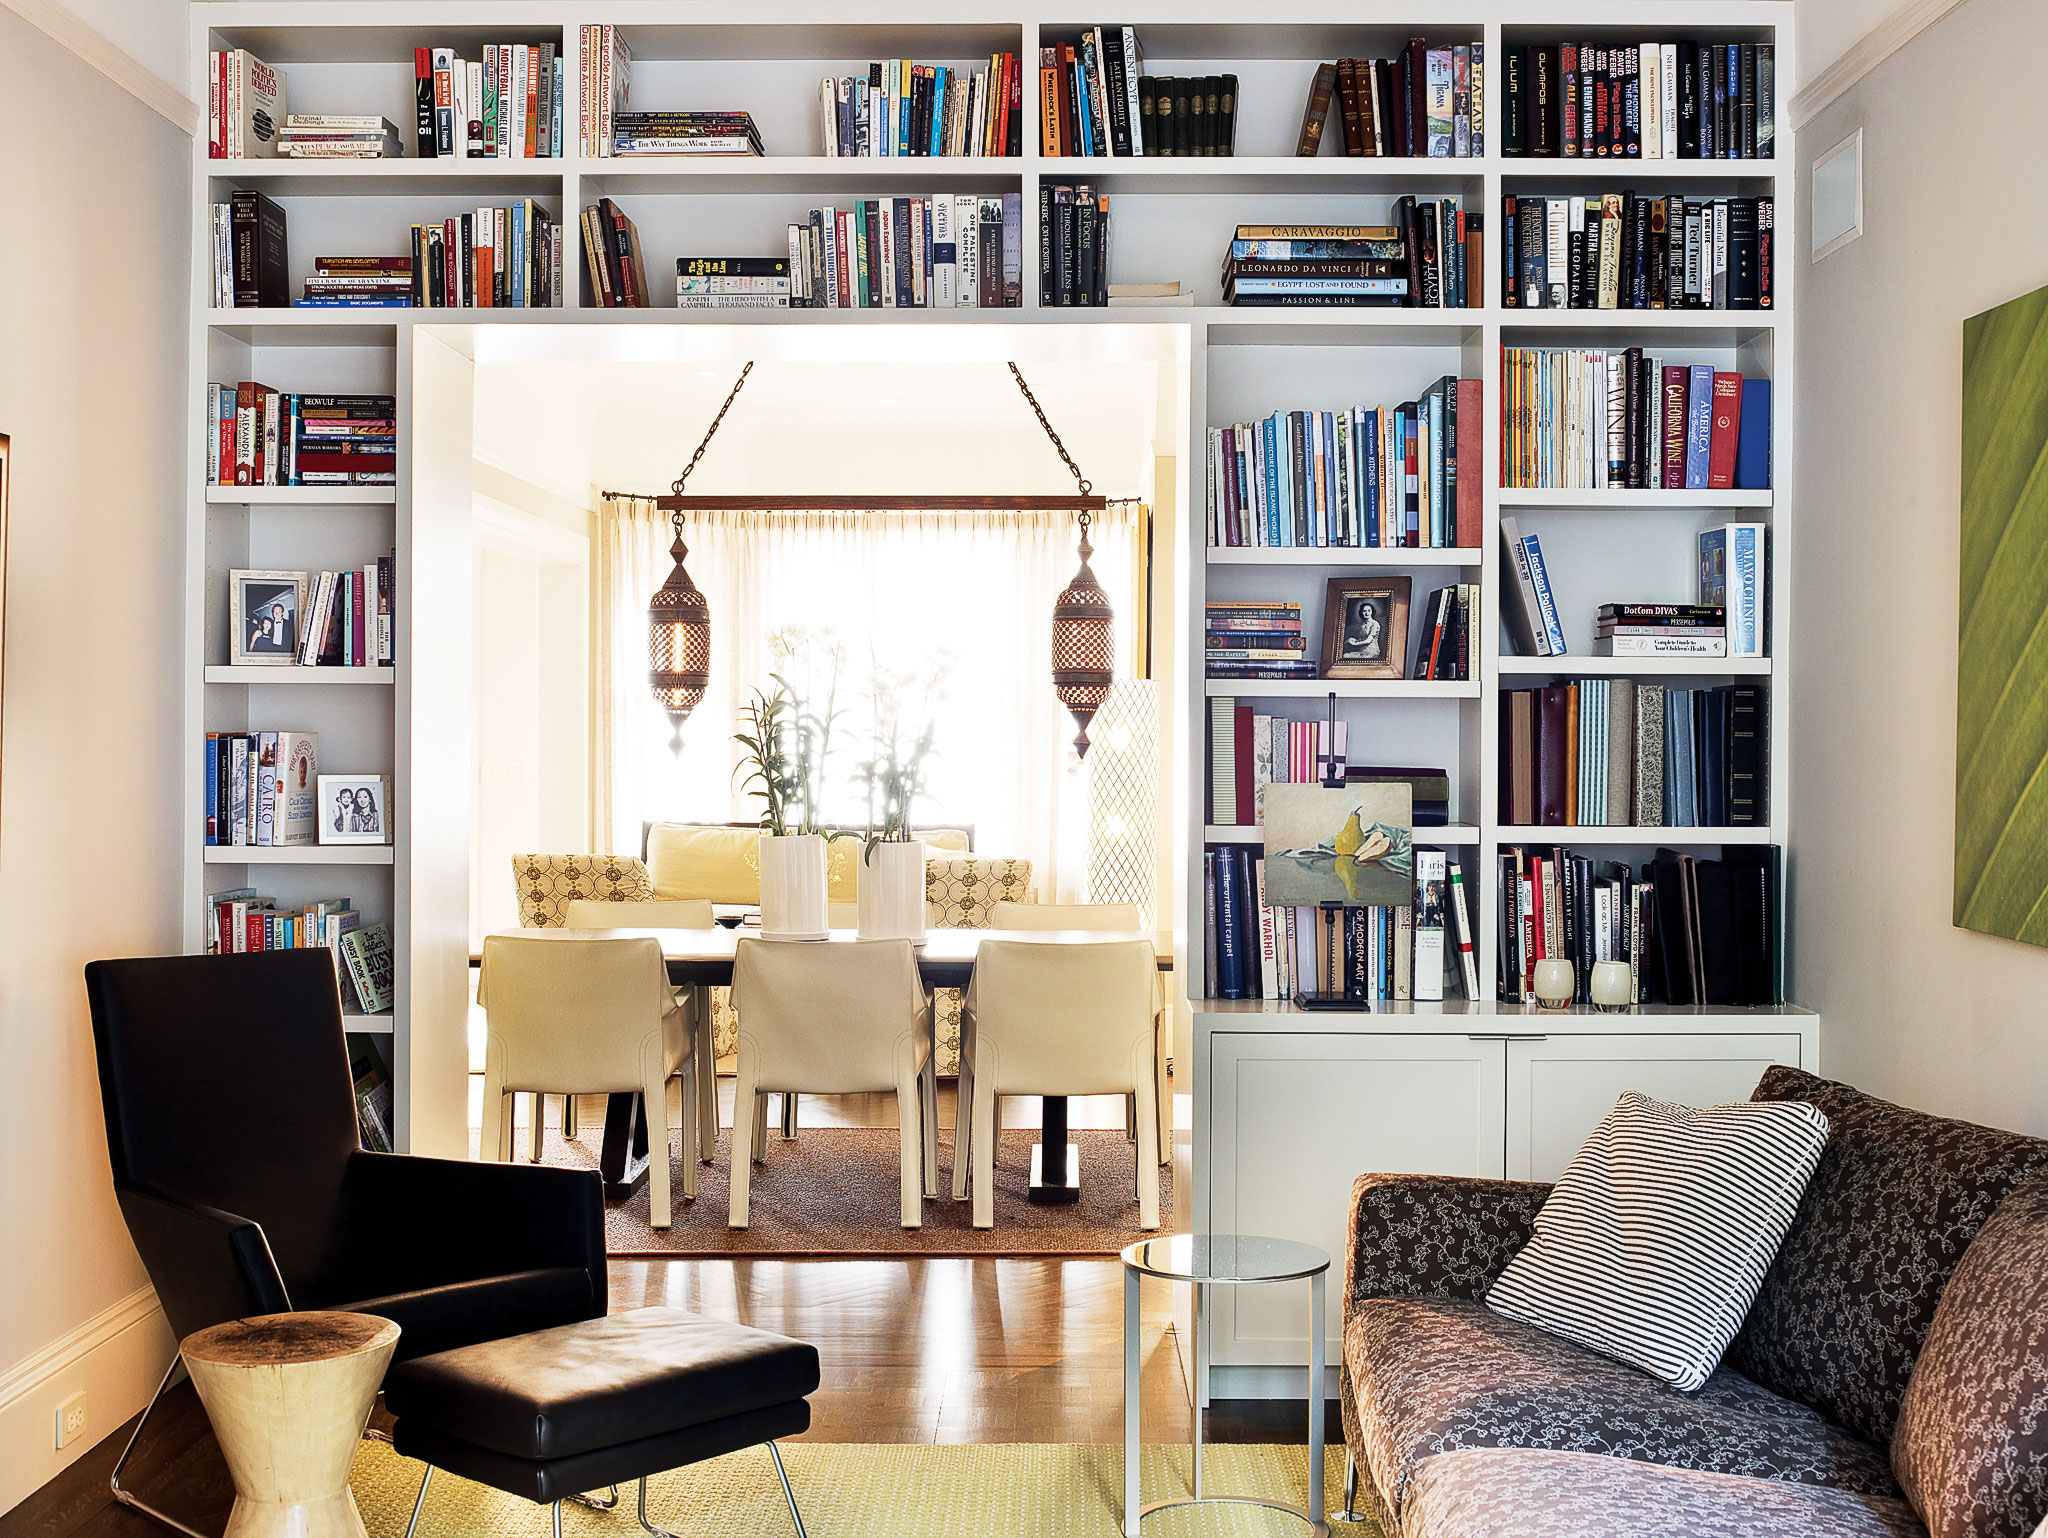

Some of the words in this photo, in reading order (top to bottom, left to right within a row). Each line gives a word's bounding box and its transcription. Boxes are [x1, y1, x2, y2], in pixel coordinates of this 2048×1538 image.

[581, 26, 589, 45] Das
[581, 47, 589, 72] dritte
[1124, 33, 1135, 74] ANCIENT
[1609, 49, 1617, 78] WEBER
[251, 68, 277, 89] POLITICS
[253, 60, 274, 79] WORLD
[500, 48, 509, 97] MONEYBALL
[1113, 61, 1122, 80] LATE
[1583, 76, 1592, 85] IN
[252, 77, 277, 97] DEBATED
[442, 80, 450, 92] World
[581, 74, 589, 113] Antwort
[602, 74, 610, 112] Antwort
[1128, 76, 1138, 106] EGYPT
[1584, 86, 1593, 111] ENEMY
[1612, 82, 1620, 103] Flag
[443, 96, 451, 105] Flat
[1116, 81, 1126, 127] ANTIQUITY
[440, 111, 448, 126] Thomas
[499, 100, 509, 127] MICHAEL
[581, 114, 589, 138] Buch
[602, 114, 610, 138] Buch
[1584, 113, 1593, 139] HANDS
[418, 127, 432, 135] Oil
[499, 127, 508, 146] LEWIS
[1049, 118, 1057, 139] LATIN
[1613, 115, 1621, 139] Exile
[1632, 124, 1639, 134] OF
[1083, 208, 1091, 218] IN
[825, 225, 833, 243] THE
[1064, 206, 1072, 249] THROUGH
[1083, 221, 1092, 249] FOCUS
[1272, 227, 1361, 237] CARAVAGGIO
[1549, 212, 1566, 268] Churchill
[1588, 222, 1598, 252] MARTHA
[1689, 223, 1699, 244] Ted
[857, 233, 866, 261] JAPAN
[1760, 234, 1769, 255] Flag
[826, 244, 835, 282] WARRIOR
[859, 261, 868, 278] INC.
[1064, 250, 1072, 268] THE
[1241, 264, 1298, 272] LEONARDO
[1321, 265, 1351, 273] VINCI
[1571, 233, 1581, 299] CLEOPATRA
[1689, 246, 1699, 287] Turner
[1064, 270, 1073, 289] LENS
[1277, 281, 1303, 289] EGYPT
[1305, 281, 1325, 289] LOST
[1340, 281, 1369, 289] FOUND
[1428, 264, 1439, 304] EGYPT
[1761, 266, 1769, 291] Exile
[828, 283, 837, 304] KING
[1666, 384, 1685, 437] CALIFORNIA
[242, 413, 250, 458] ALEXANDER
[1699, 400, 1709, 453] AMERICA
[1666, 438, 1683, 463] WINE
[1269, 469, 1274, 477] OF
[1743, 548, 1754, 585] MAYO
[1529, 551, 1546, 592] Jackson
[1539, 592, 1556, 629] Pollock
[1624, 606, 1654, 615] DotCom
[1654, 607, 1678, 615] DIVAS
[1743, 586, 1754, 632] CLINIC
[261, 774, 275, 824] CAIRO
[1223, 890, 1233, 927] oriental
[1356, 910, 1364, 922] OF
[1224, 929, 1233, 957] carpet
[1263, 918, 1273, 962] WARHOL
[1356, 923, 1364, 961] MODERN
[1525, 920, 1534, 958] AMERICA
[346, 942, 359, 960] BUSY
[353, 960, 365, 980] BOOK
[1356, 961, 1364, 982] ART
